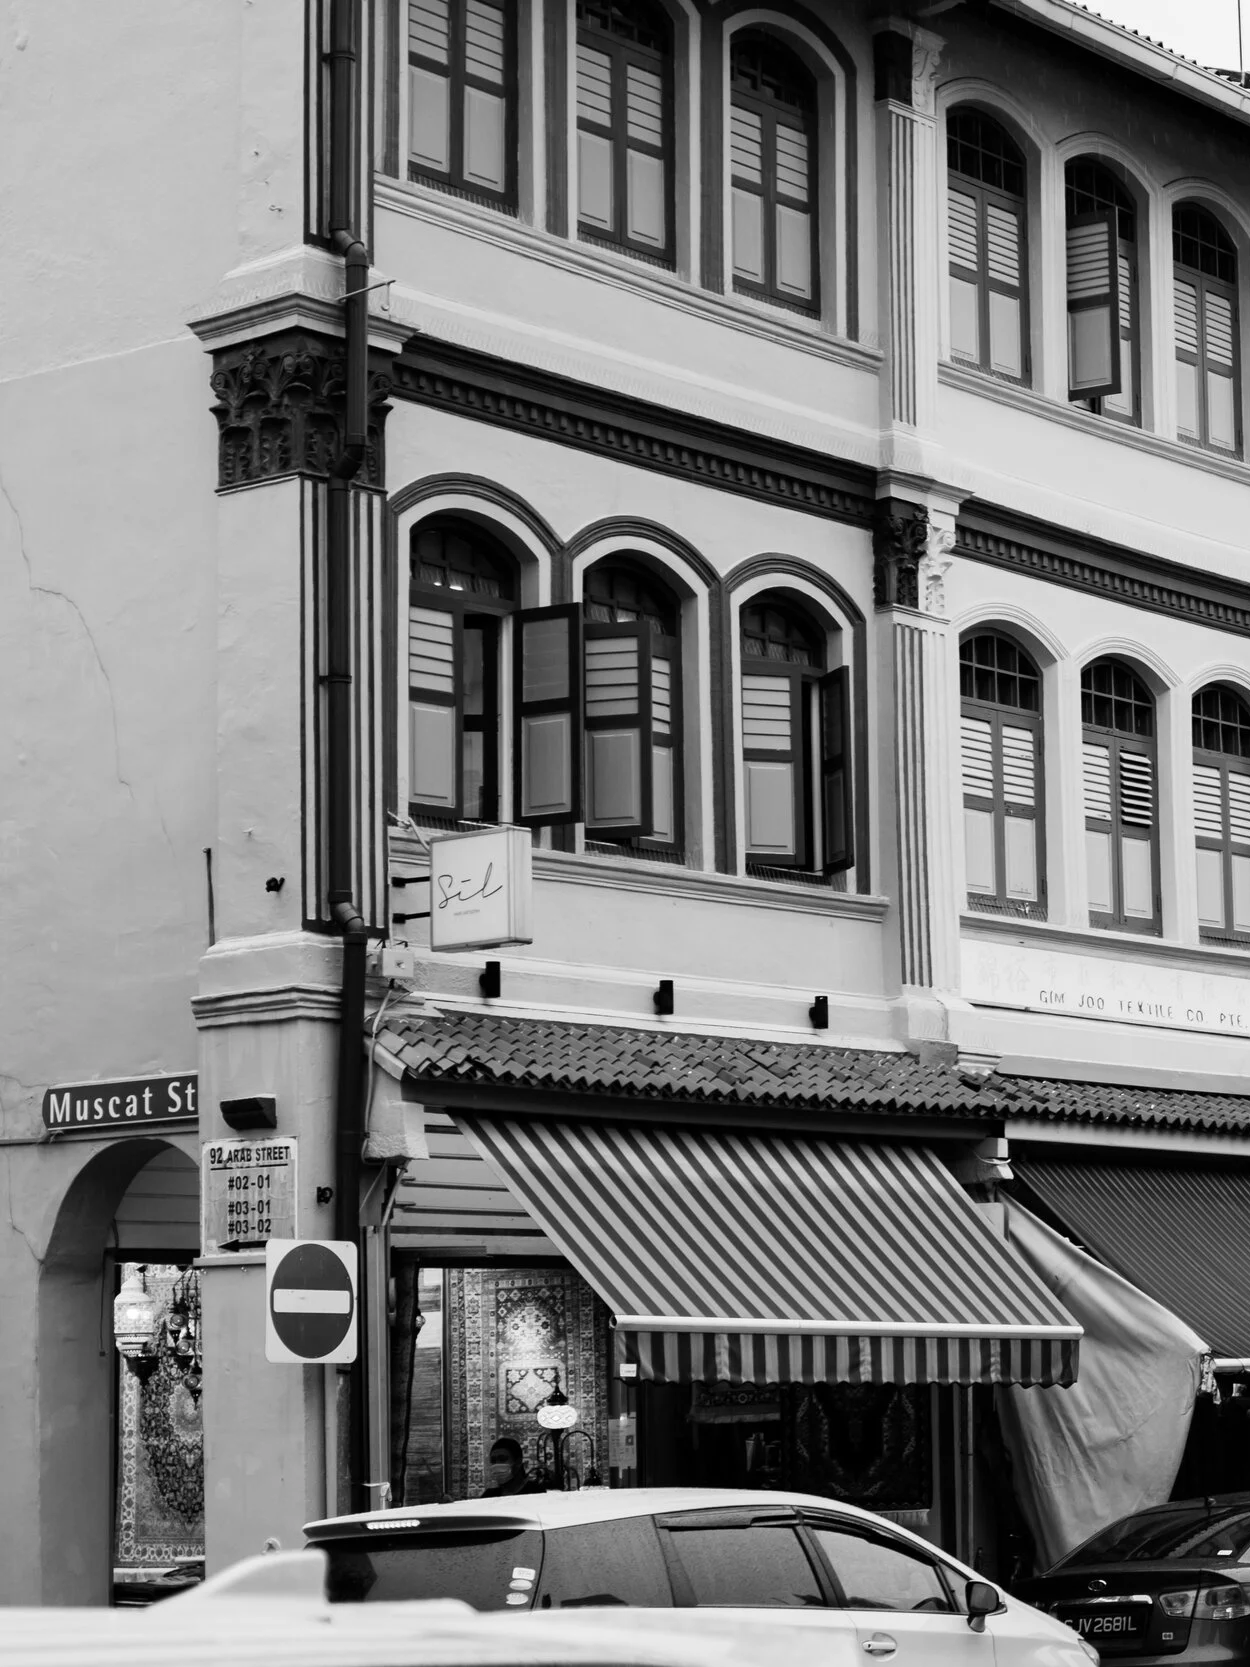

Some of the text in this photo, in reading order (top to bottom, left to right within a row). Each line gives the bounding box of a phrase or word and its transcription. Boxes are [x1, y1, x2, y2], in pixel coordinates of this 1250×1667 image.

[1039, 990, 1065, 1004] GIM
[1078, 994, 1106, 1010] JOO
[50, 1081, 196, 1124] Muscat St
[210, 1146, 290, 1165] 92 ARAB STREET
[228, 1174, 271, 1190] #02-01
[228, 1200, 271, 1216] #03-01
[228, 1218, 271, 1235] #03-02
